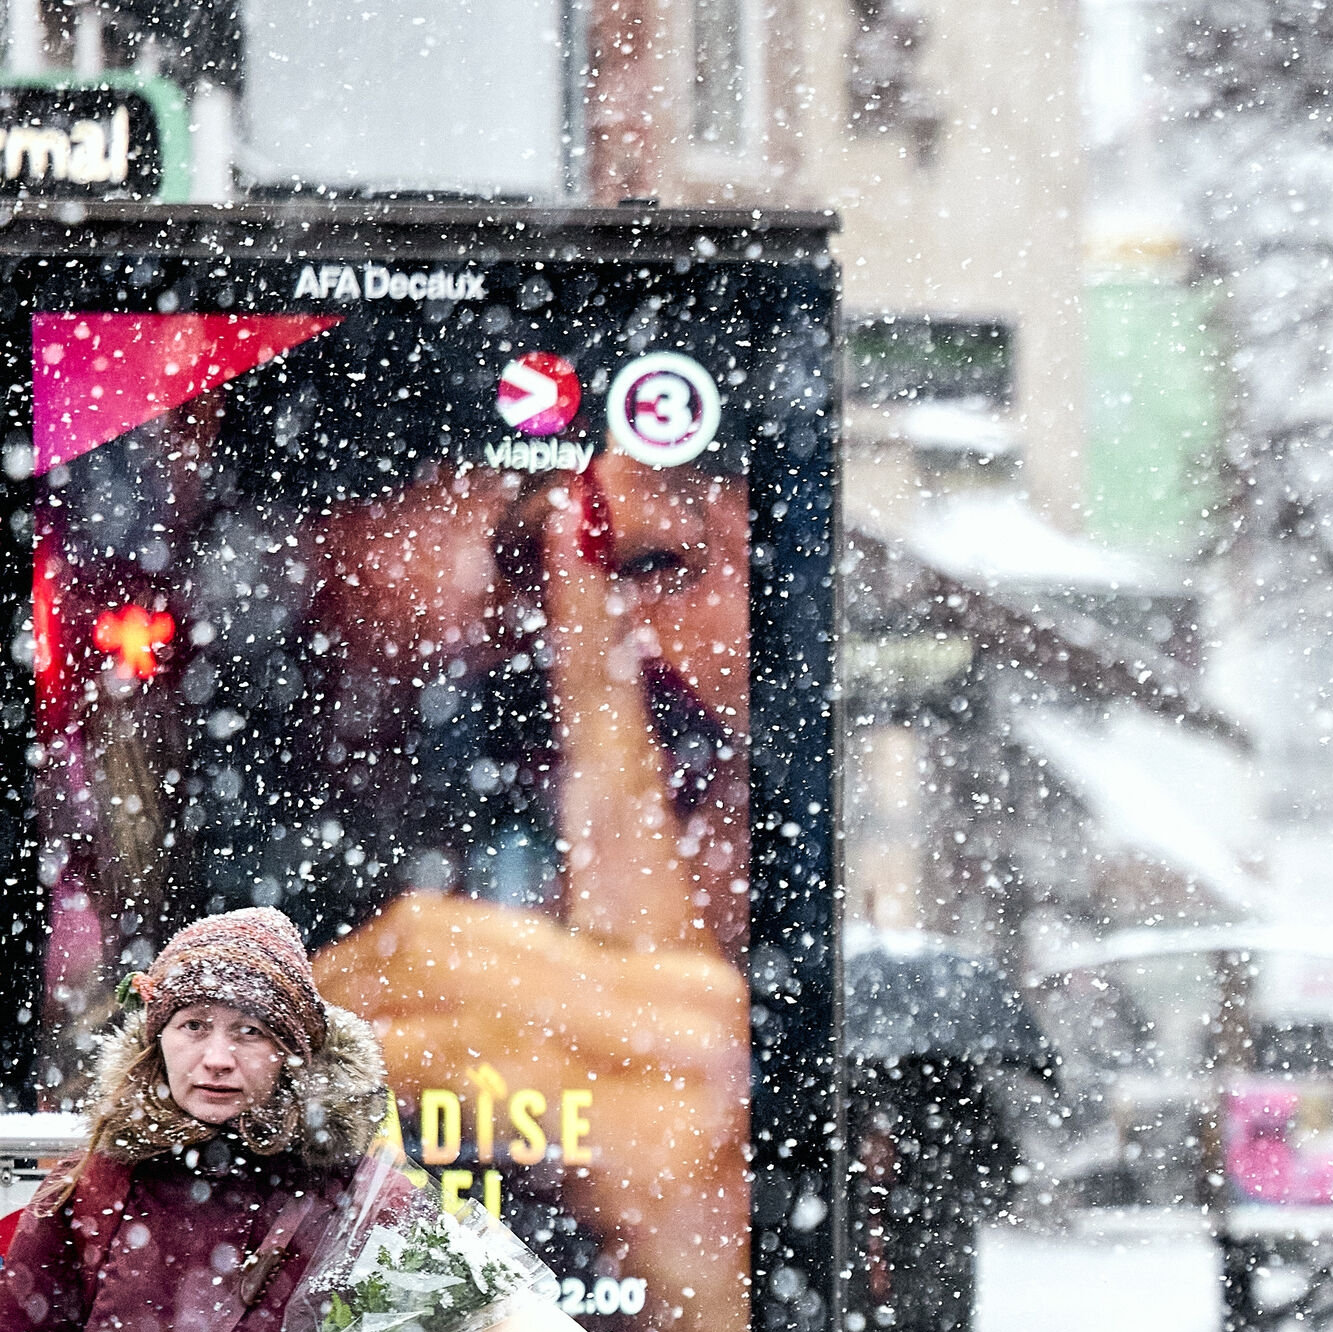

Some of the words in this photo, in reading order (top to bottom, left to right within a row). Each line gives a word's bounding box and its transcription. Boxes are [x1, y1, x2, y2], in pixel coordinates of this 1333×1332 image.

[0, 105, 129, 184] mal
[293, 265, 361, 300] AFA
[363, 264, 486, 300] Decaux
[635, 374, 697, 441] 3
[484, 436, 594, 474] viaplay
